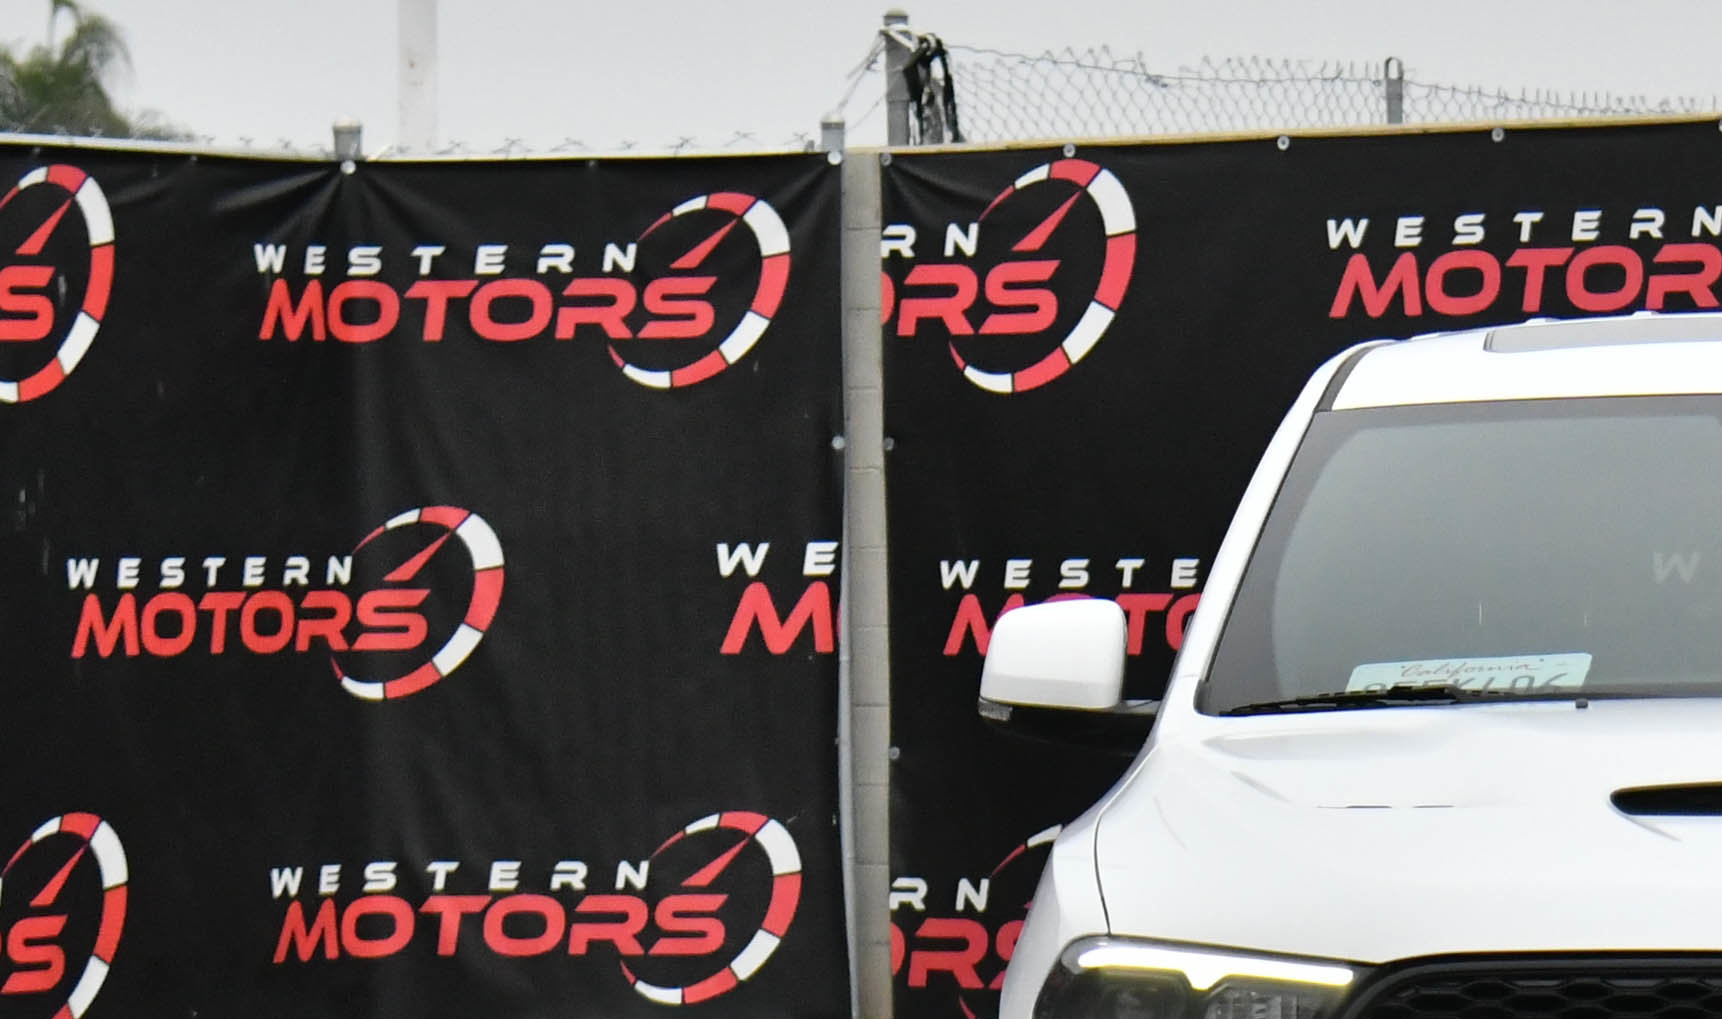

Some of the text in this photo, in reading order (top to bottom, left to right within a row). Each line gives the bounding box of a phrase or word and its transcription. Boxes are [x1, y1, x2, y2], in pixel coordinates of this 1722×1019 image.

[254, 243, 638, 276] WESTERN
[258, 275, 718, 344] MOTORS
[881, 259, 1061, 337] RS
[67, 555, 353, 589] WESTERN
[716, 540, 839, 578] WE
[940, 557, 1200, 590] WESTE
[71, 588, 431, 659] MOTORS
[720, 580, 841, 655] M
[270, 860, 650, 898] WESTERN
[273, 893, 729, 964] MOTORS
